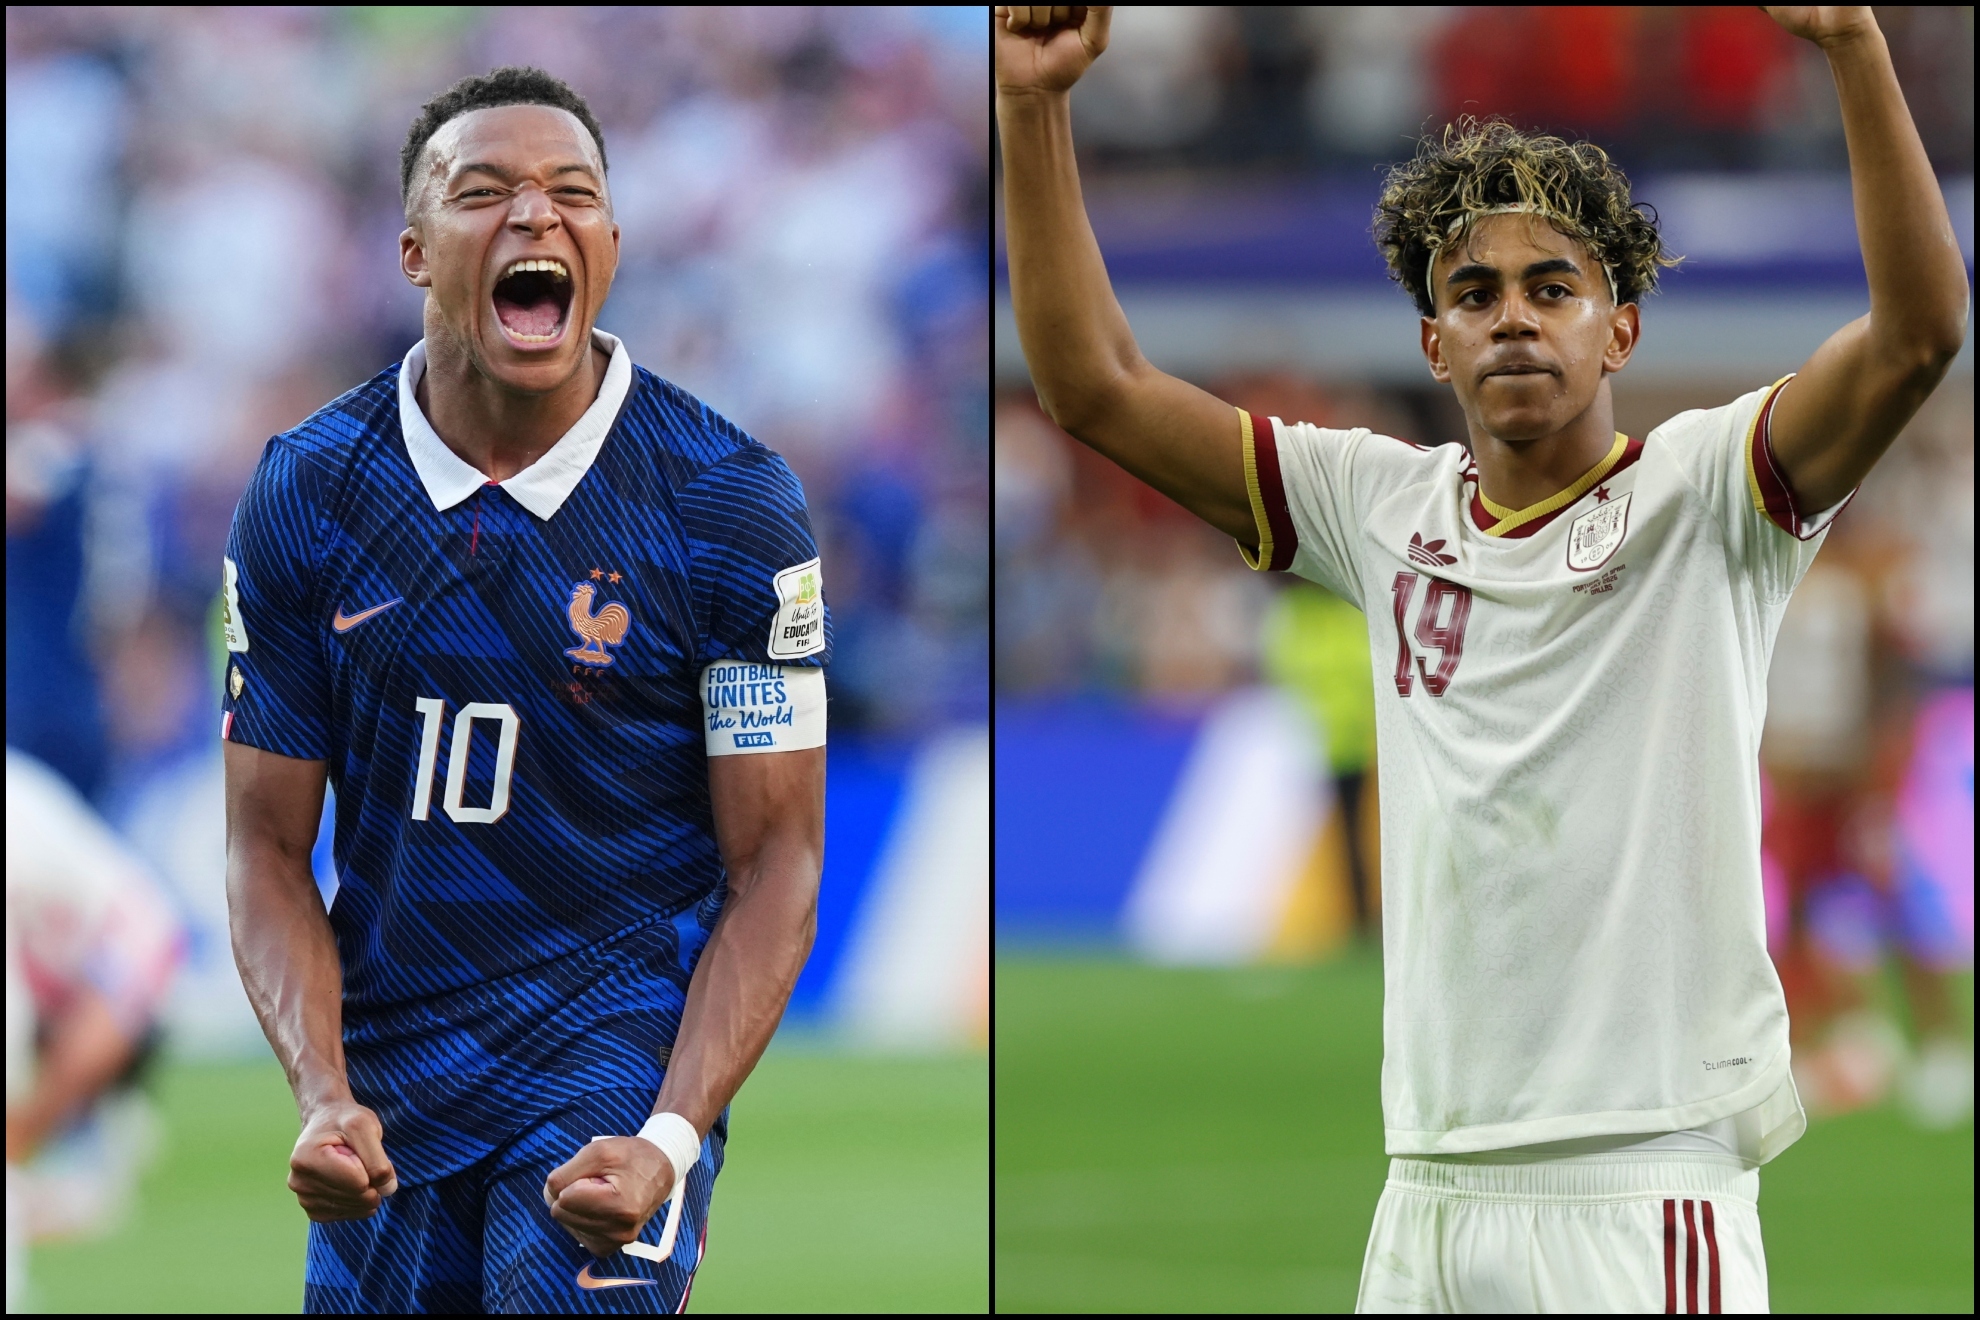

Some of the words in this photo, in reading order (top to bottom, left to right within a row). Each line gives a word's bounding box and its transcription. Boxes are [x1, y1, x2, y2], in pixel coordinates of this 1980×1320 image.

[1590, 583, 1613, 595] DALLAS
[1391, 571, 1473, 698] 19
[708, 664, 784, 684] FOOTBALL
[707, 681, 787, 709] UNITES
[708, 711, 736, 731] the
[739, 705, 793, 728] World
[737, 734, 771, 746] FIFA
[411, 696, 521, 824] 10
